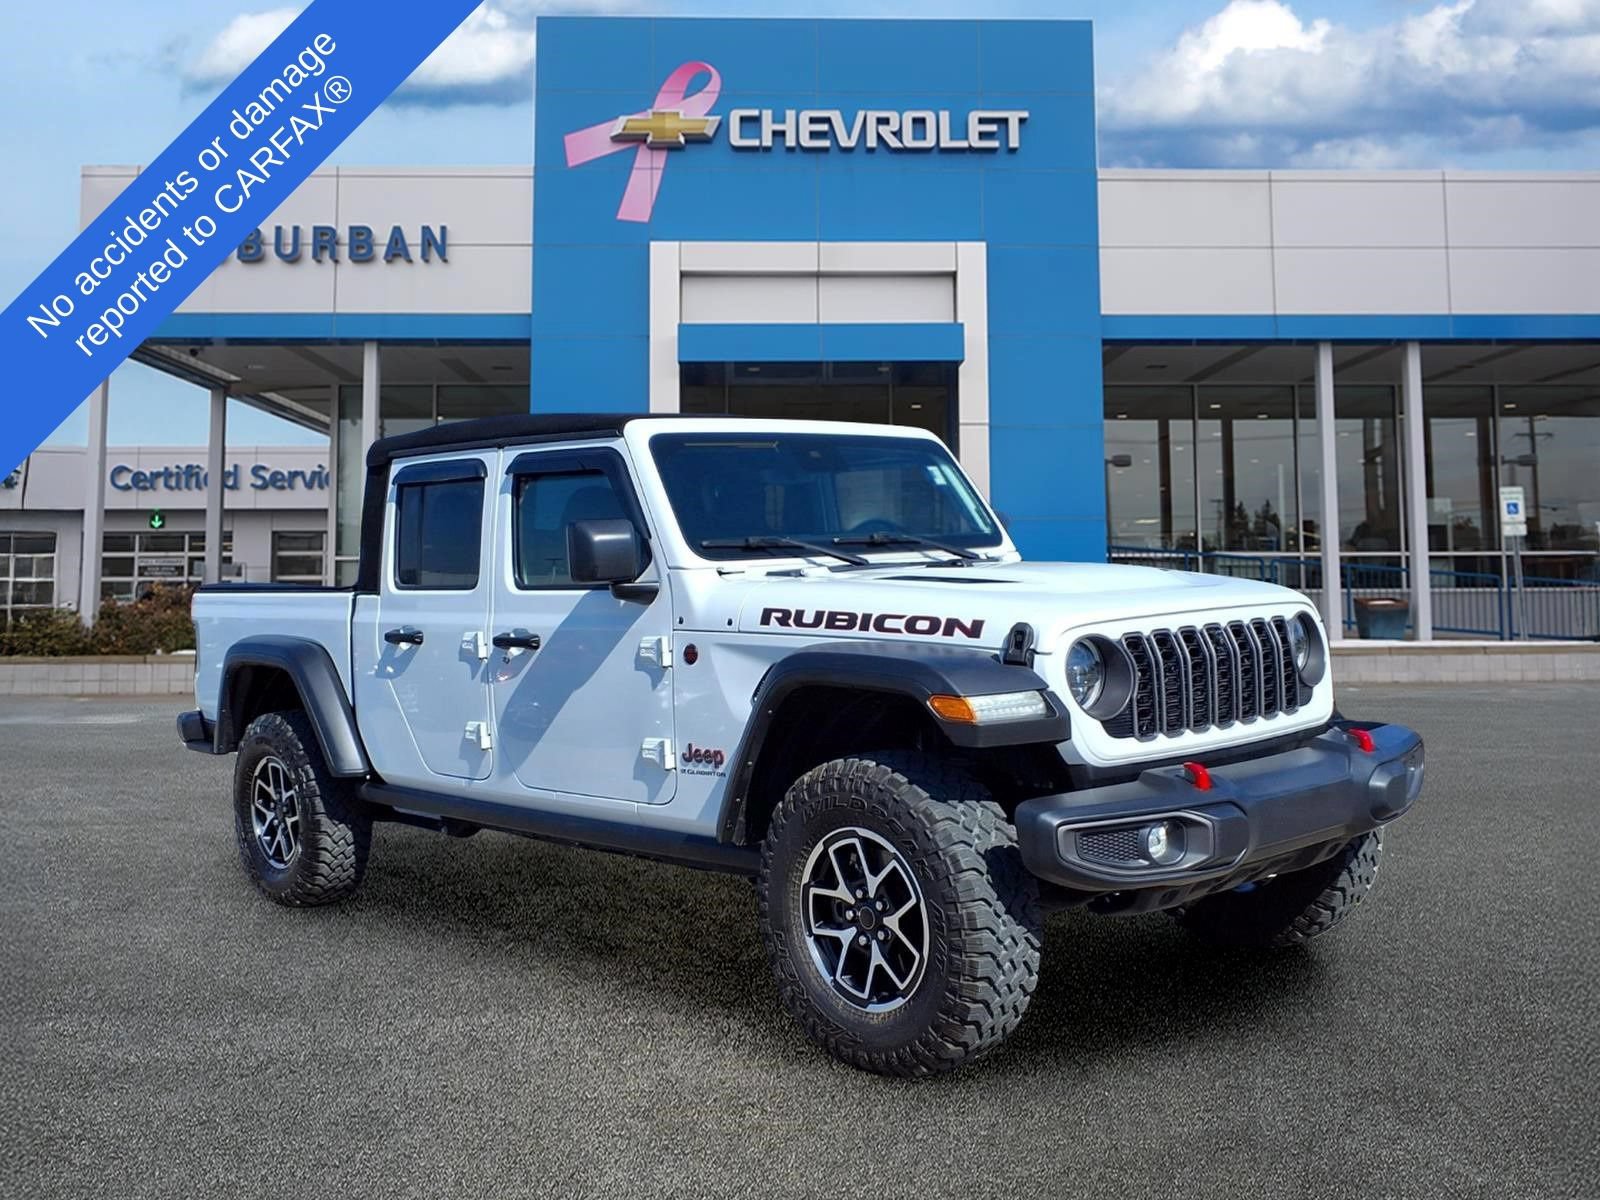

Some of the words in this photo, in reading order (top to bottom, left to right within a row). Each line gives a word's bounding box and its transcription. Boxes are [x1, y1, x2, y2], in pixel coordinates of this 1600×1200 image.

[729, 109, 1029, 150] CHEVROLET
[221, 225, 449, 264] BURBAN
[110, 464, 240, 491] Certifid
[759, 607, 985, 639] RUBICON
[681, 742, 725, 769] Jeep
